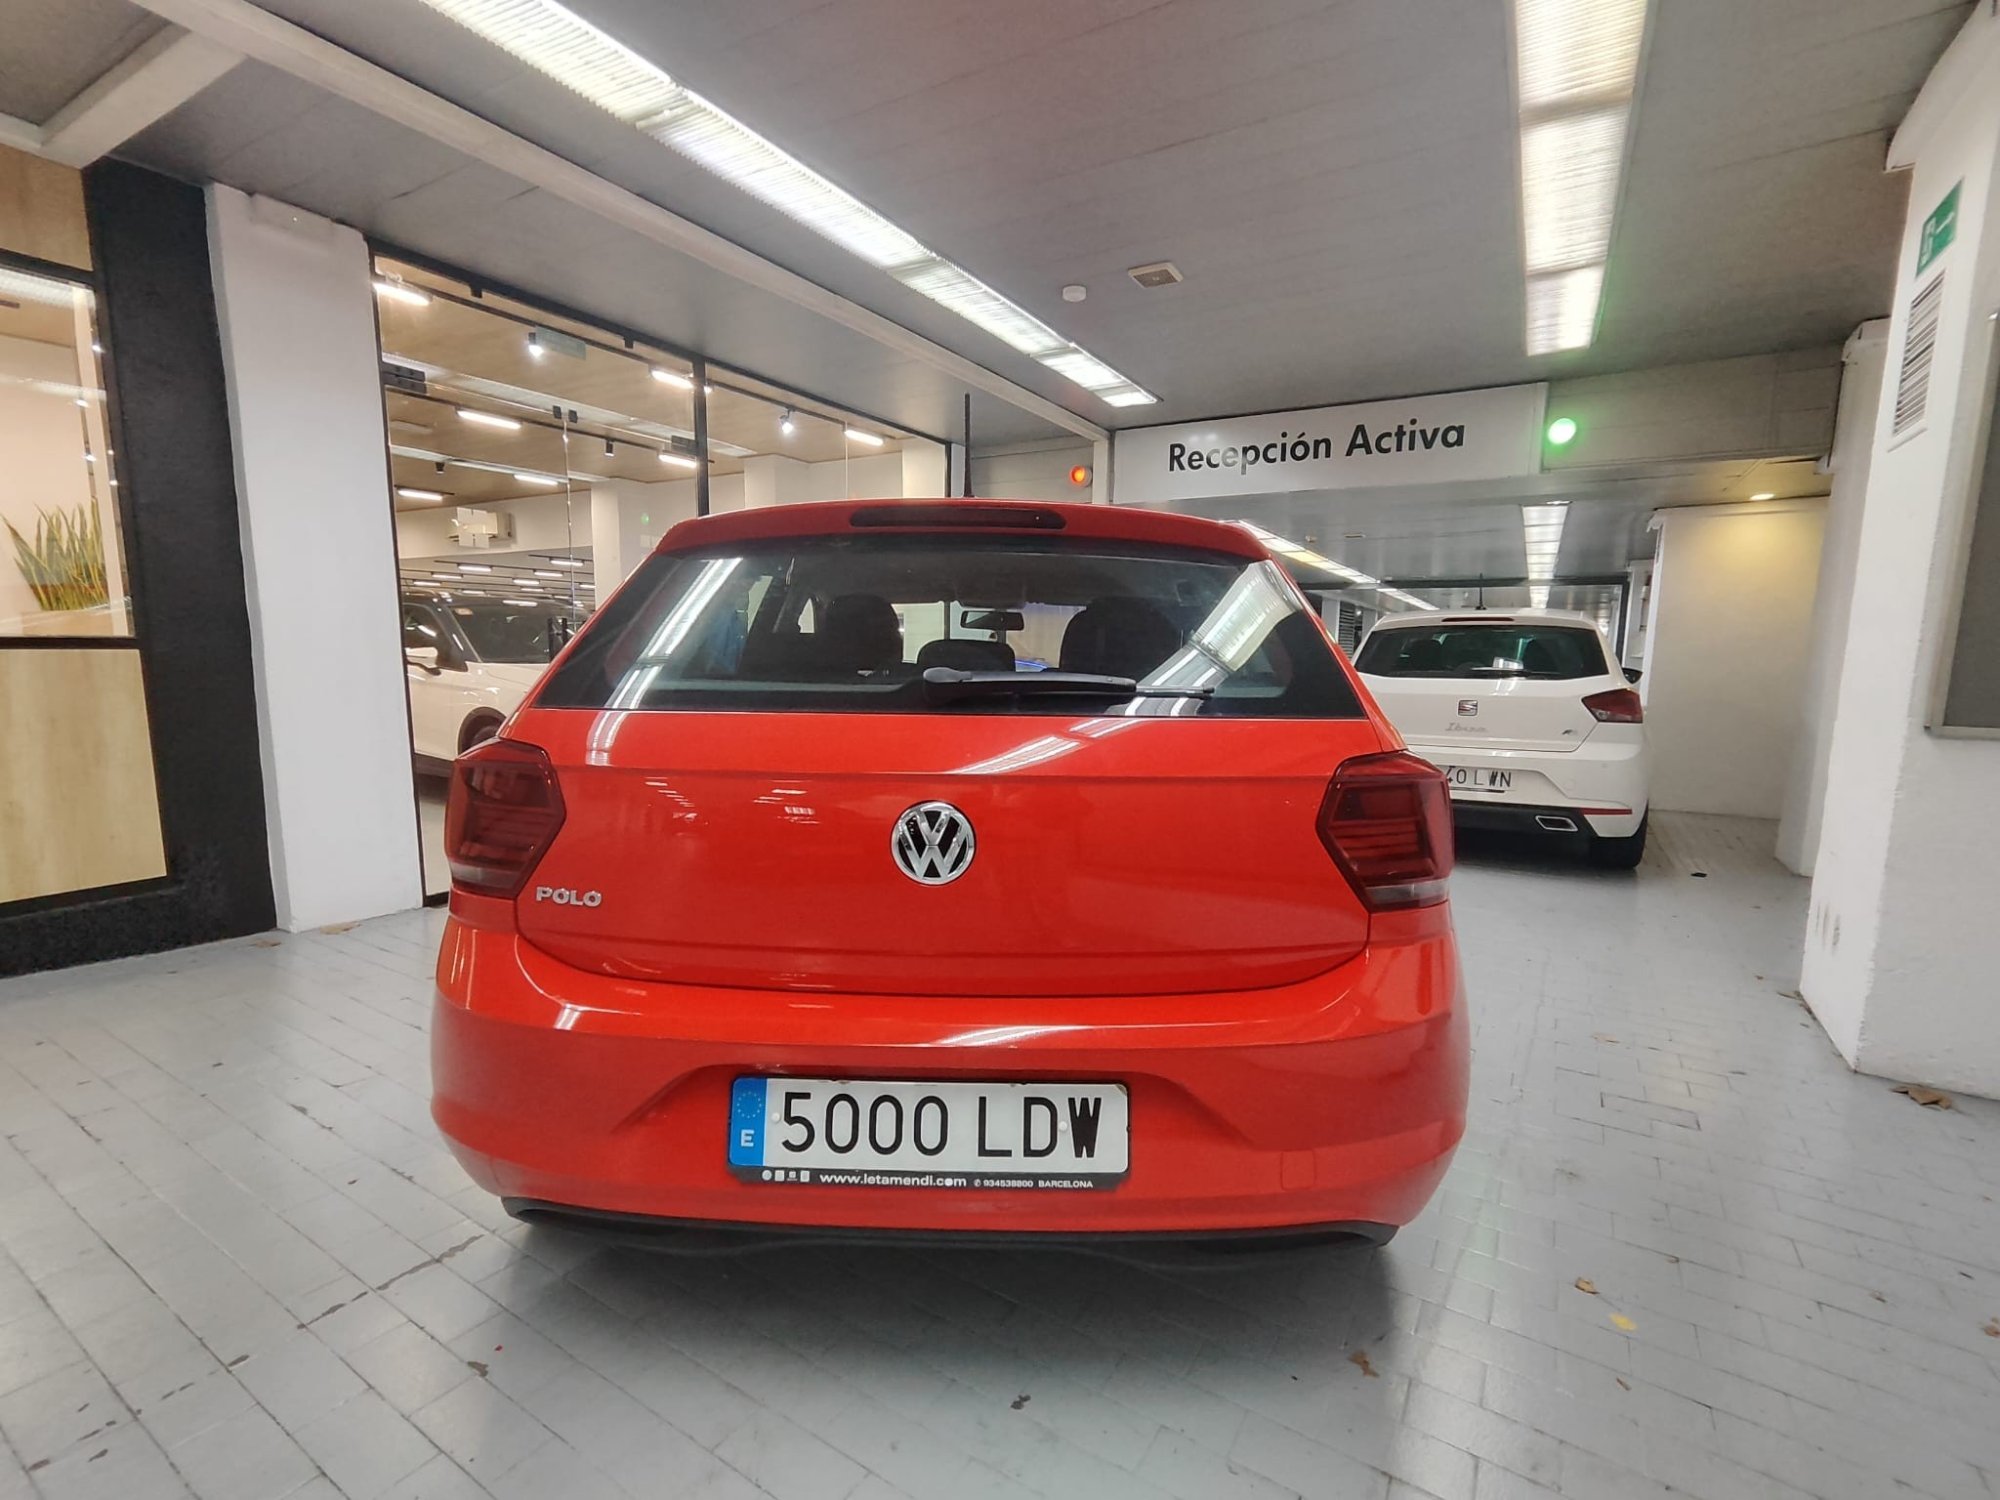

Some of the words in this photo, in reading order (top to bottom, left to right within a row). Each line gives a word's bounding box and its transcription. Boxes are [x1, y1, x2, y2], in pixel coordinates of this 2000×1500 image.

[1168, 431, 1332, 475] Recepción
[1345, 417, 1465, 457] Activa
[536, 886, 602, 907] POLO
[781, 1091, 949, 1157] 5000
[977, 1096, 1102, 1159] LDW
[740, 1129, 755, 1148] E
[1038, 1180, 1094, 1189] BARCELONA
